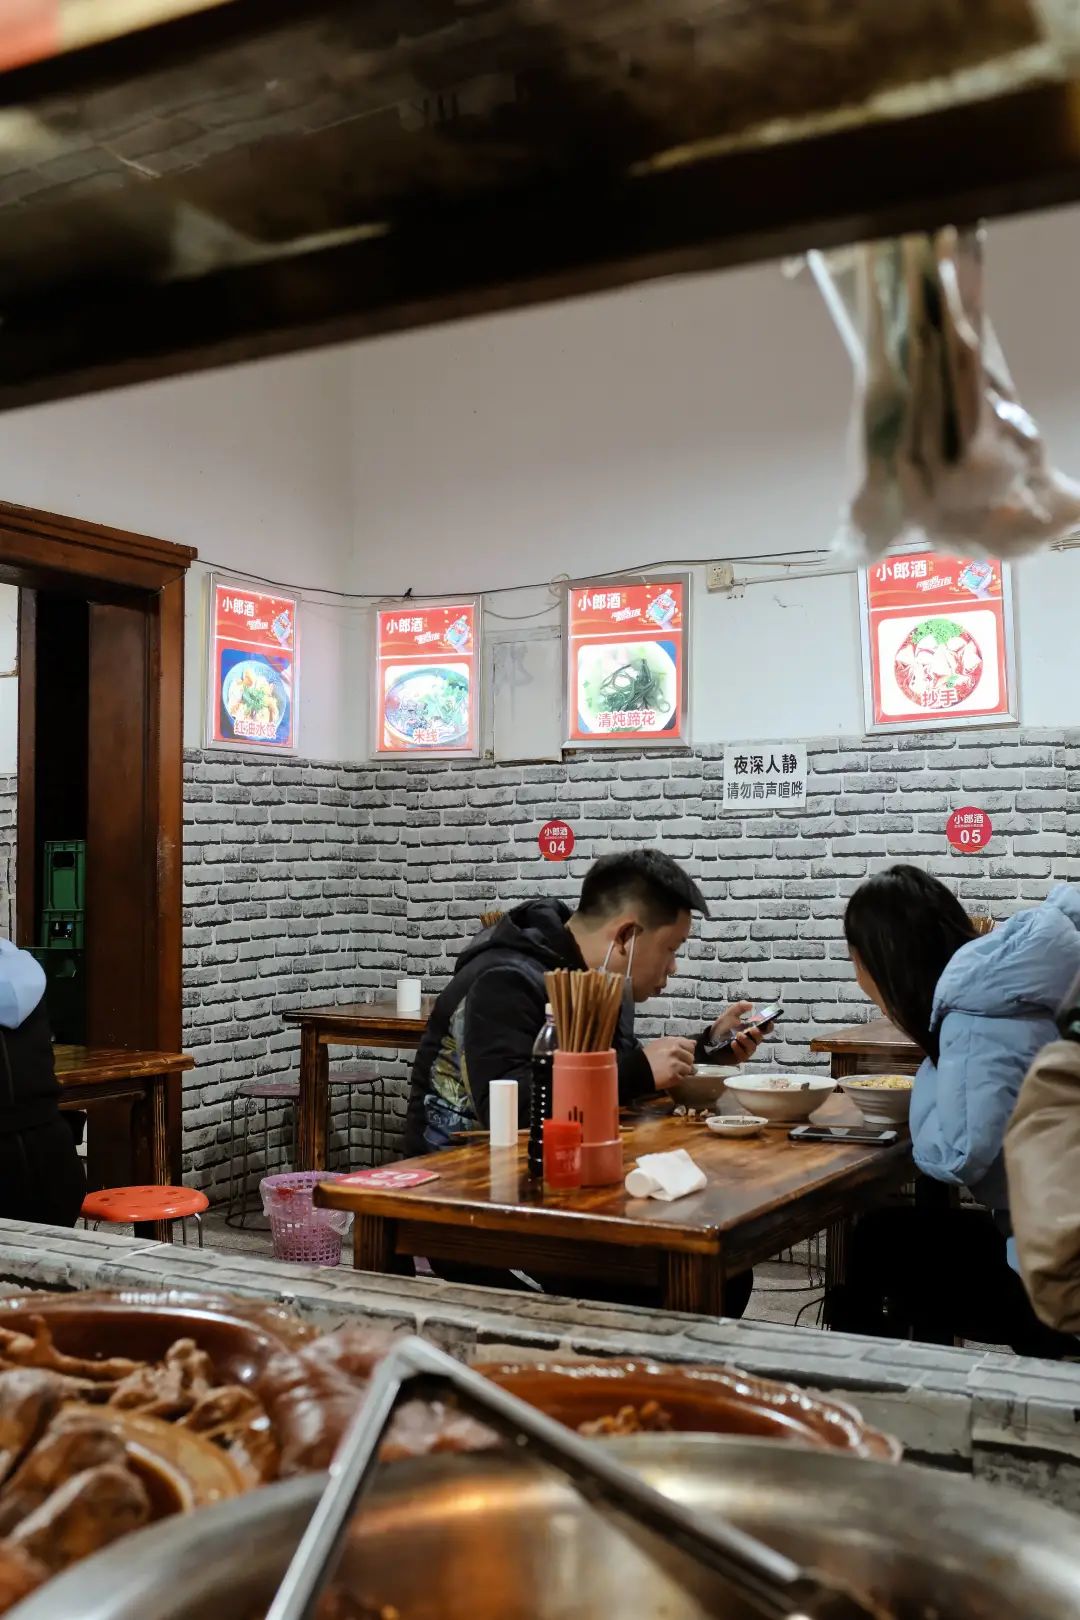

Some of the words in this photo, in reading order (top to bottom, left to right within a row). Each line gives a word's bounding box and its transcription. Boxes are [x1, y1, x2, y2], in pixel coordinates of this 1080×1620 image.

[876, 559, 928, 582] 小郎酒
[222, 596, 255, 617] 小郎酒
[577, 592, 621, 611] 小郎酒
[386, 617, 423, 634] 小郎酒
[921, 689, 958, 707] 抄手
[598, 710, 656, 728] 清炖蹄花
[414, 729, 438, 743] 米线
[733, 753, 798, 775] 夜深人静
[727, 780, 803, 800] 请勿高声喧哗
[953, 813, 984, 825] 小郎酒
[960, 829, 981, 844] 05
[549, 840, 566, 854] 04
